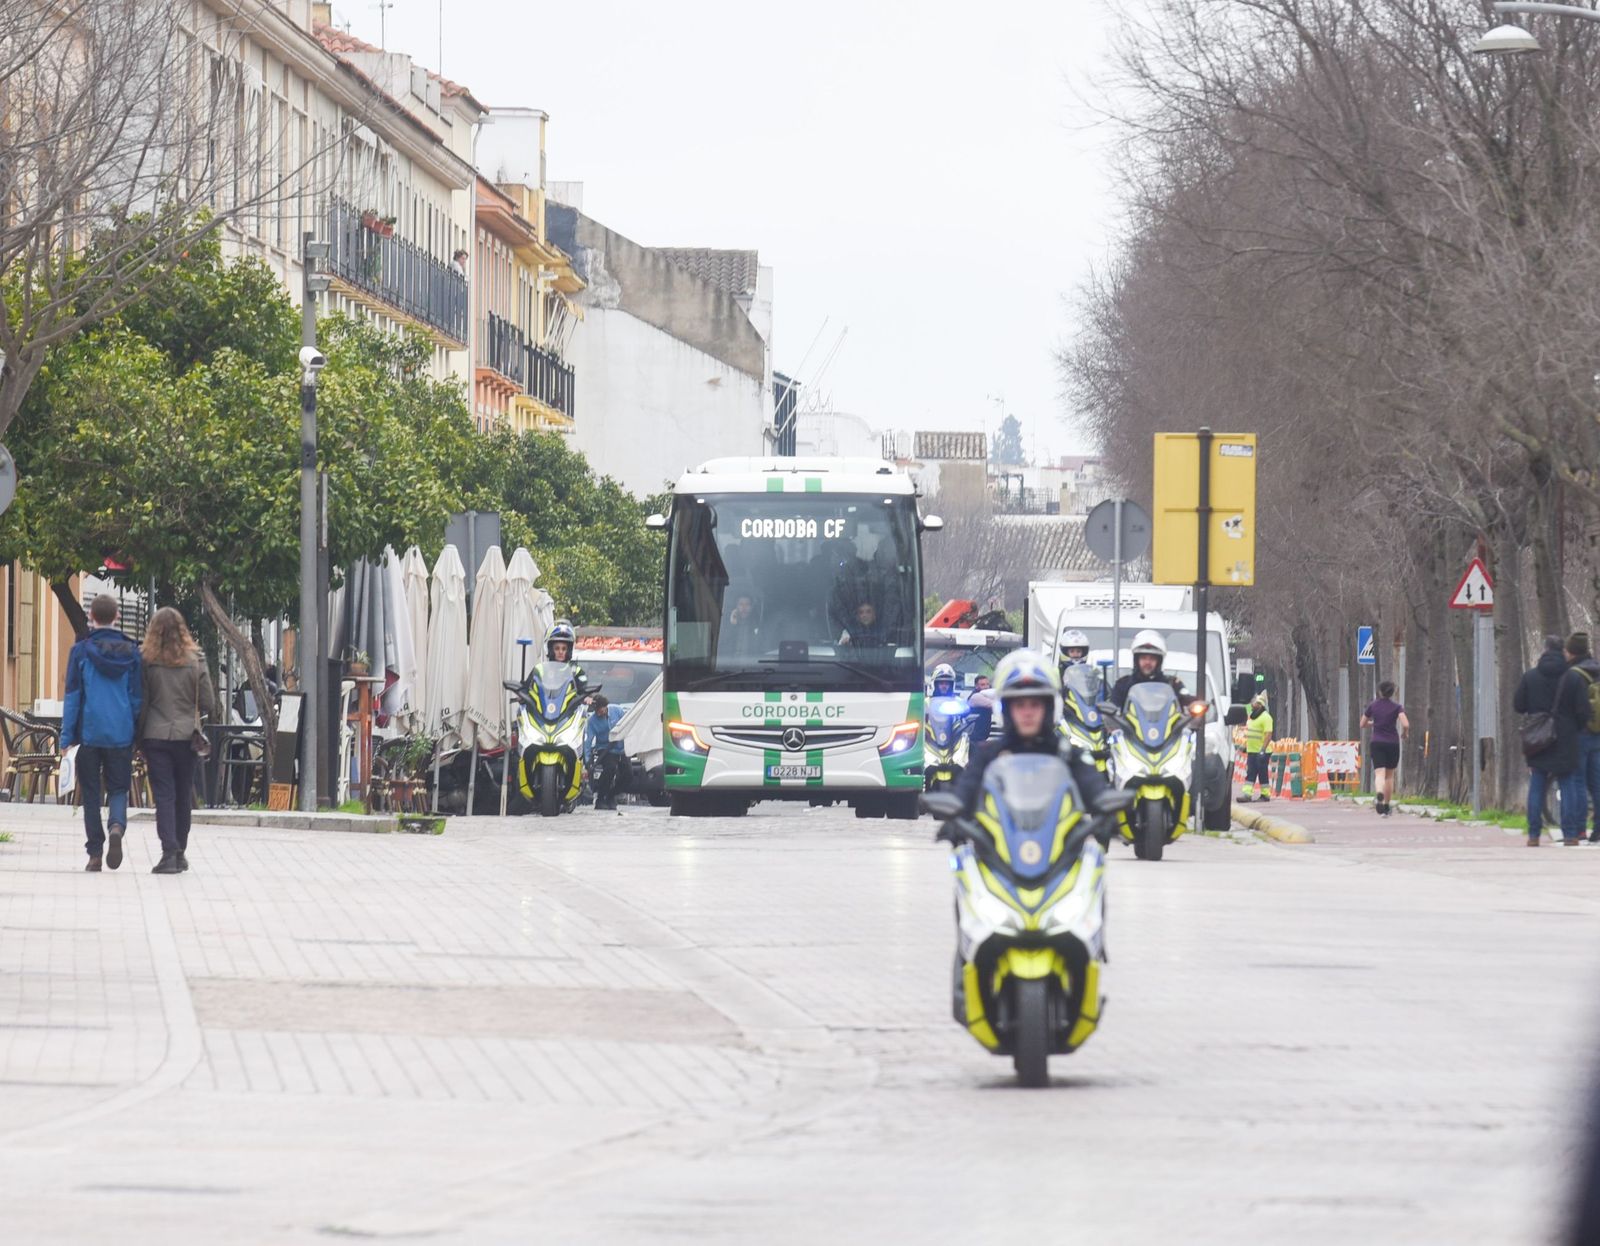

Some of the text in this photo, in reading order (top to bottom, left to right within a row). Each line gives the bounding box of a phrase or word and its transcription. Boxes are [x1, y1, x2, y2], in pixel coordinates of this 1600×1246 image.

[742, 519, 845, 538] CORDOBA CF
[825, 706, 846, 718] CF
[773, 767, 819, 777] 0228 NJT
